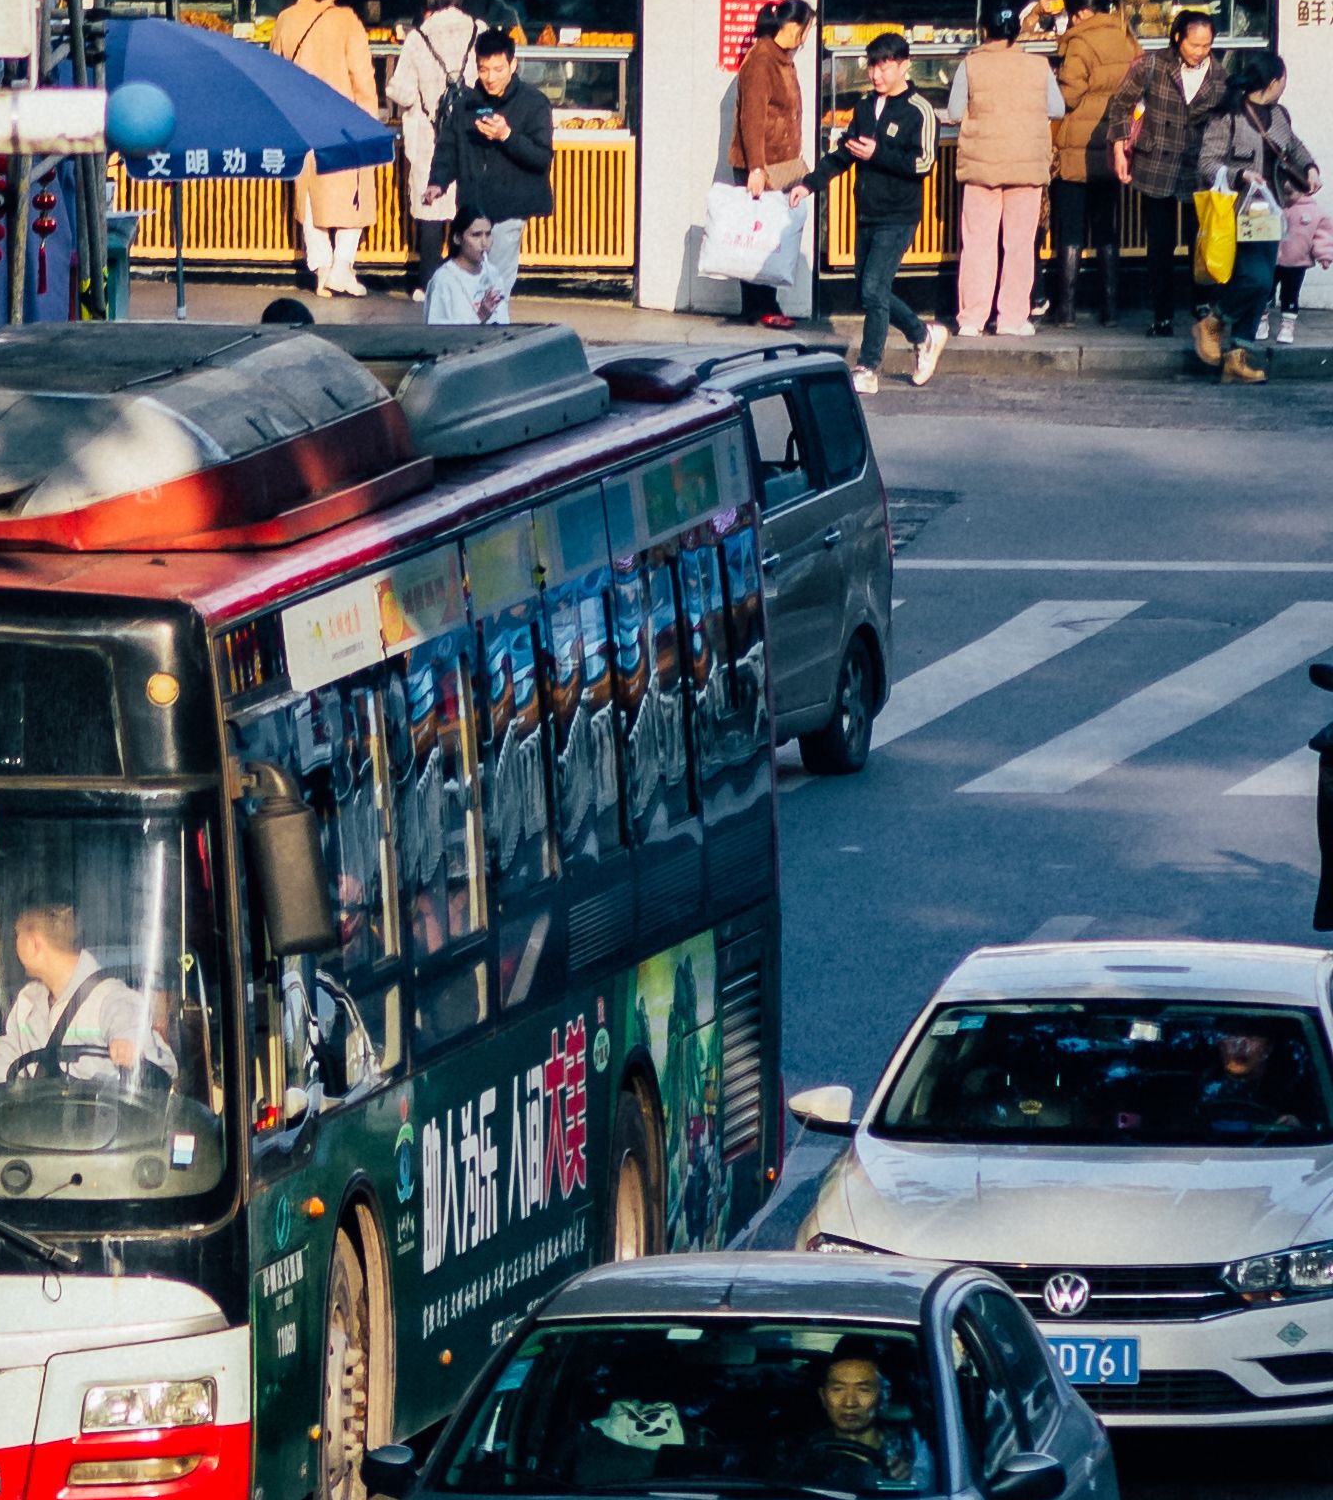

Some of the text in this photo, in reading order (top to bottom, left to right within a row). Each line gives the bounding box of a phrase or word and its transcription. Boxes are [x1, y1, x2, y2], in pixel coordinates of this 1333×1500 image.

[1298, 0, 1333, 26] 鲜
[147, 148, 286, 177] 文明劝导
[422, 1013, 587, 1275] 助人为乐 人间大美
[1051, 1345, 1130, 1378] D761
